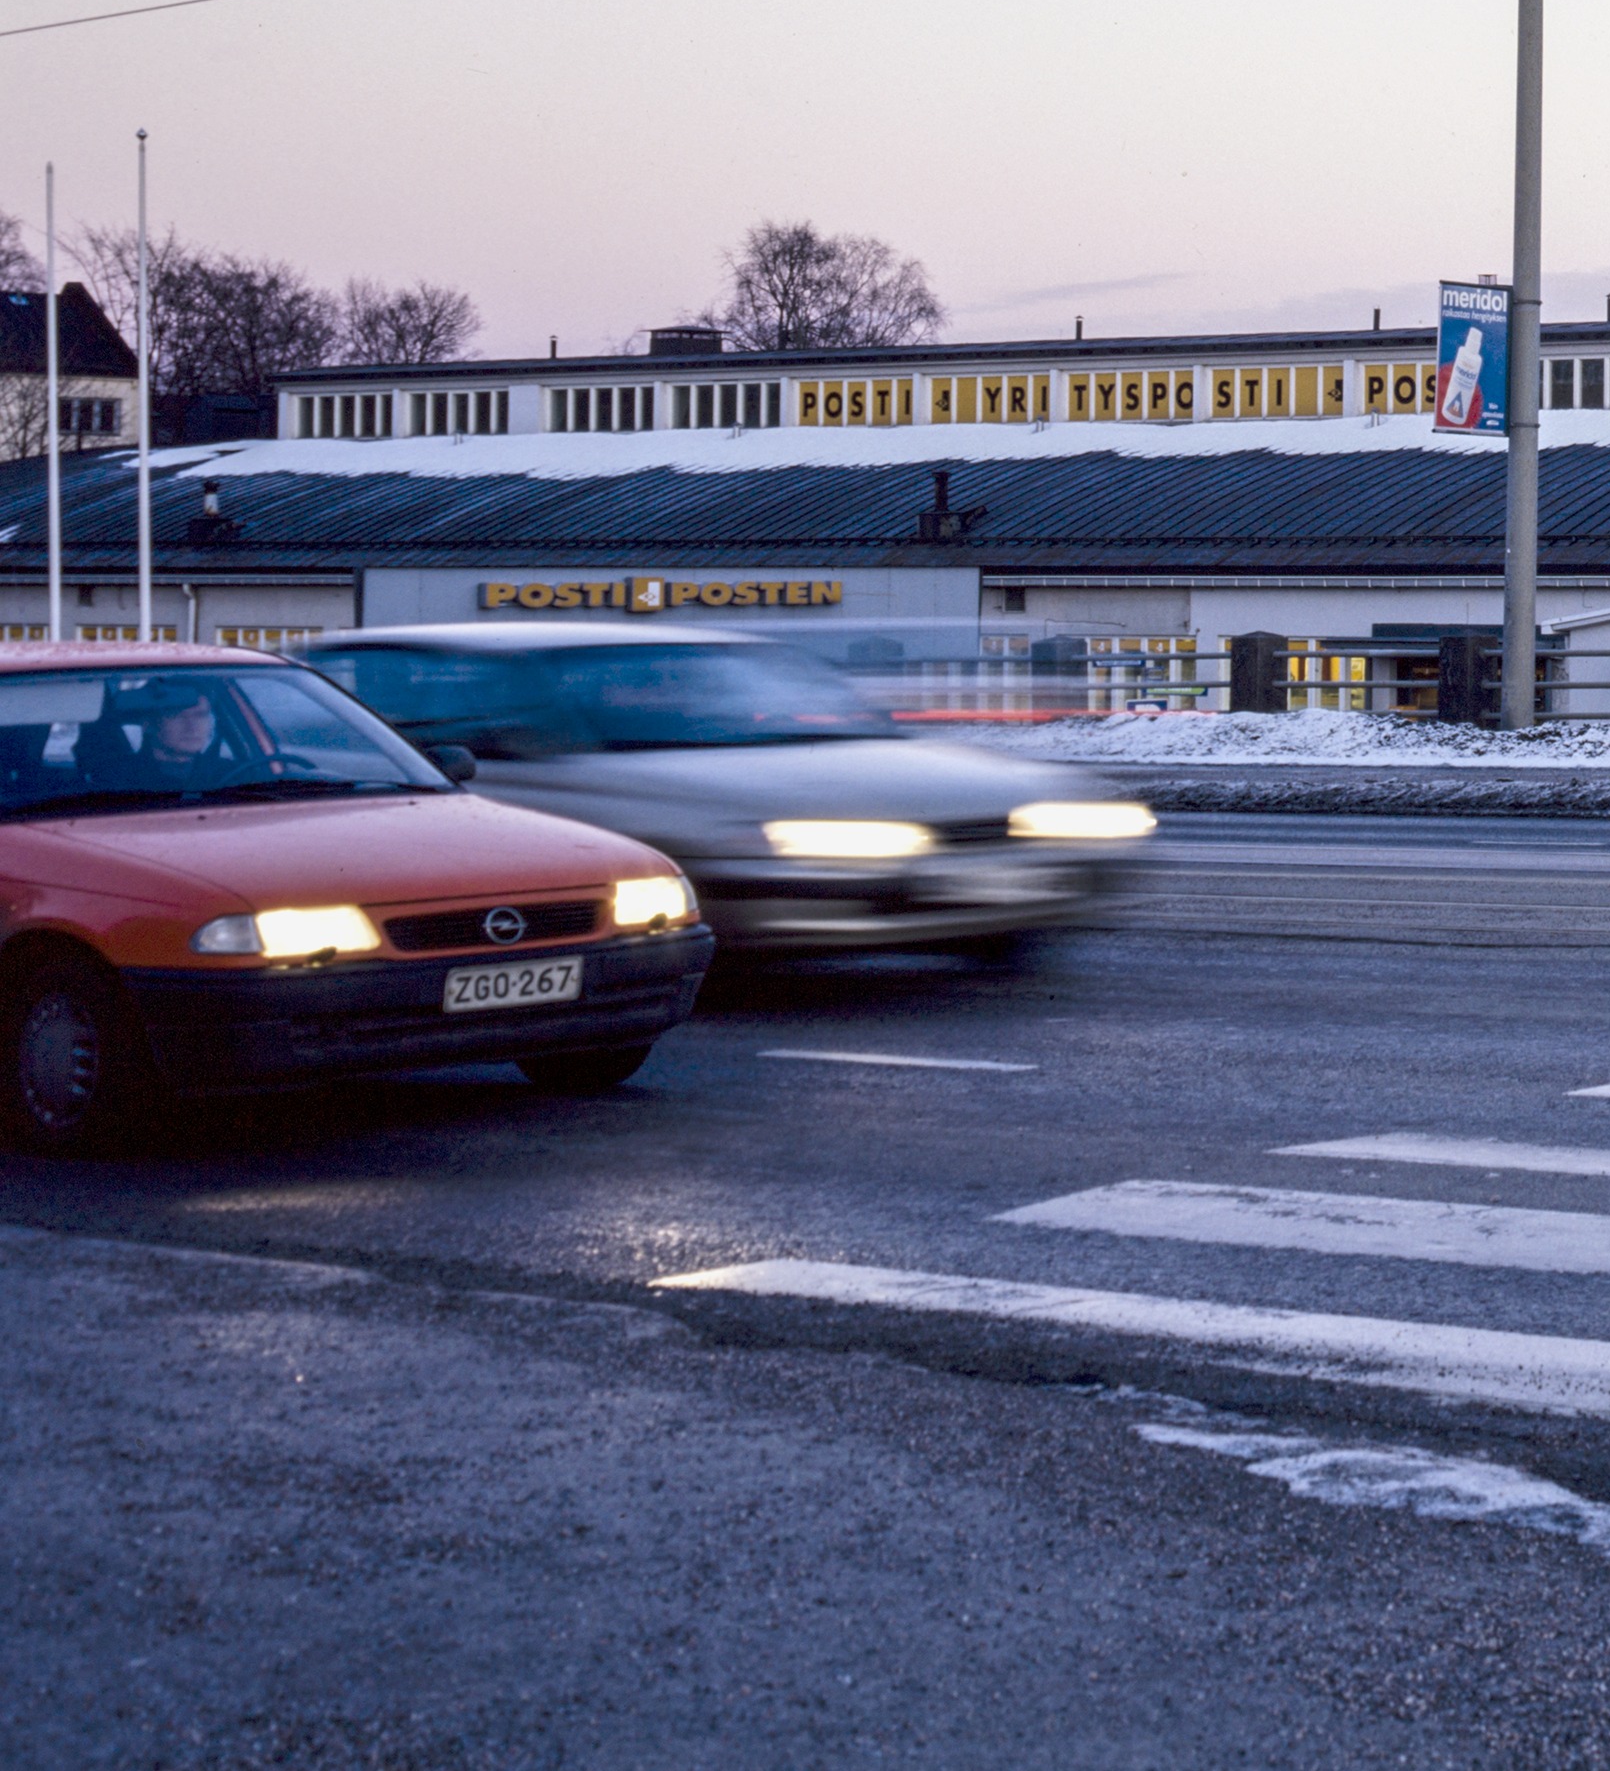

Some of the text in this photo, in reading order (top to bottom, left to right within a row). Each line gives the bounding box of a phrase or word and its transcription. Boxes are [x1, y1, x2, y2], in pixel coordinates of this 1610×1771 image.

[1442, 289, 1508, 312] meridol
[802, 389, 911, 418] POSTI
[484, 580, 843, 608] POSTI POSTEN
